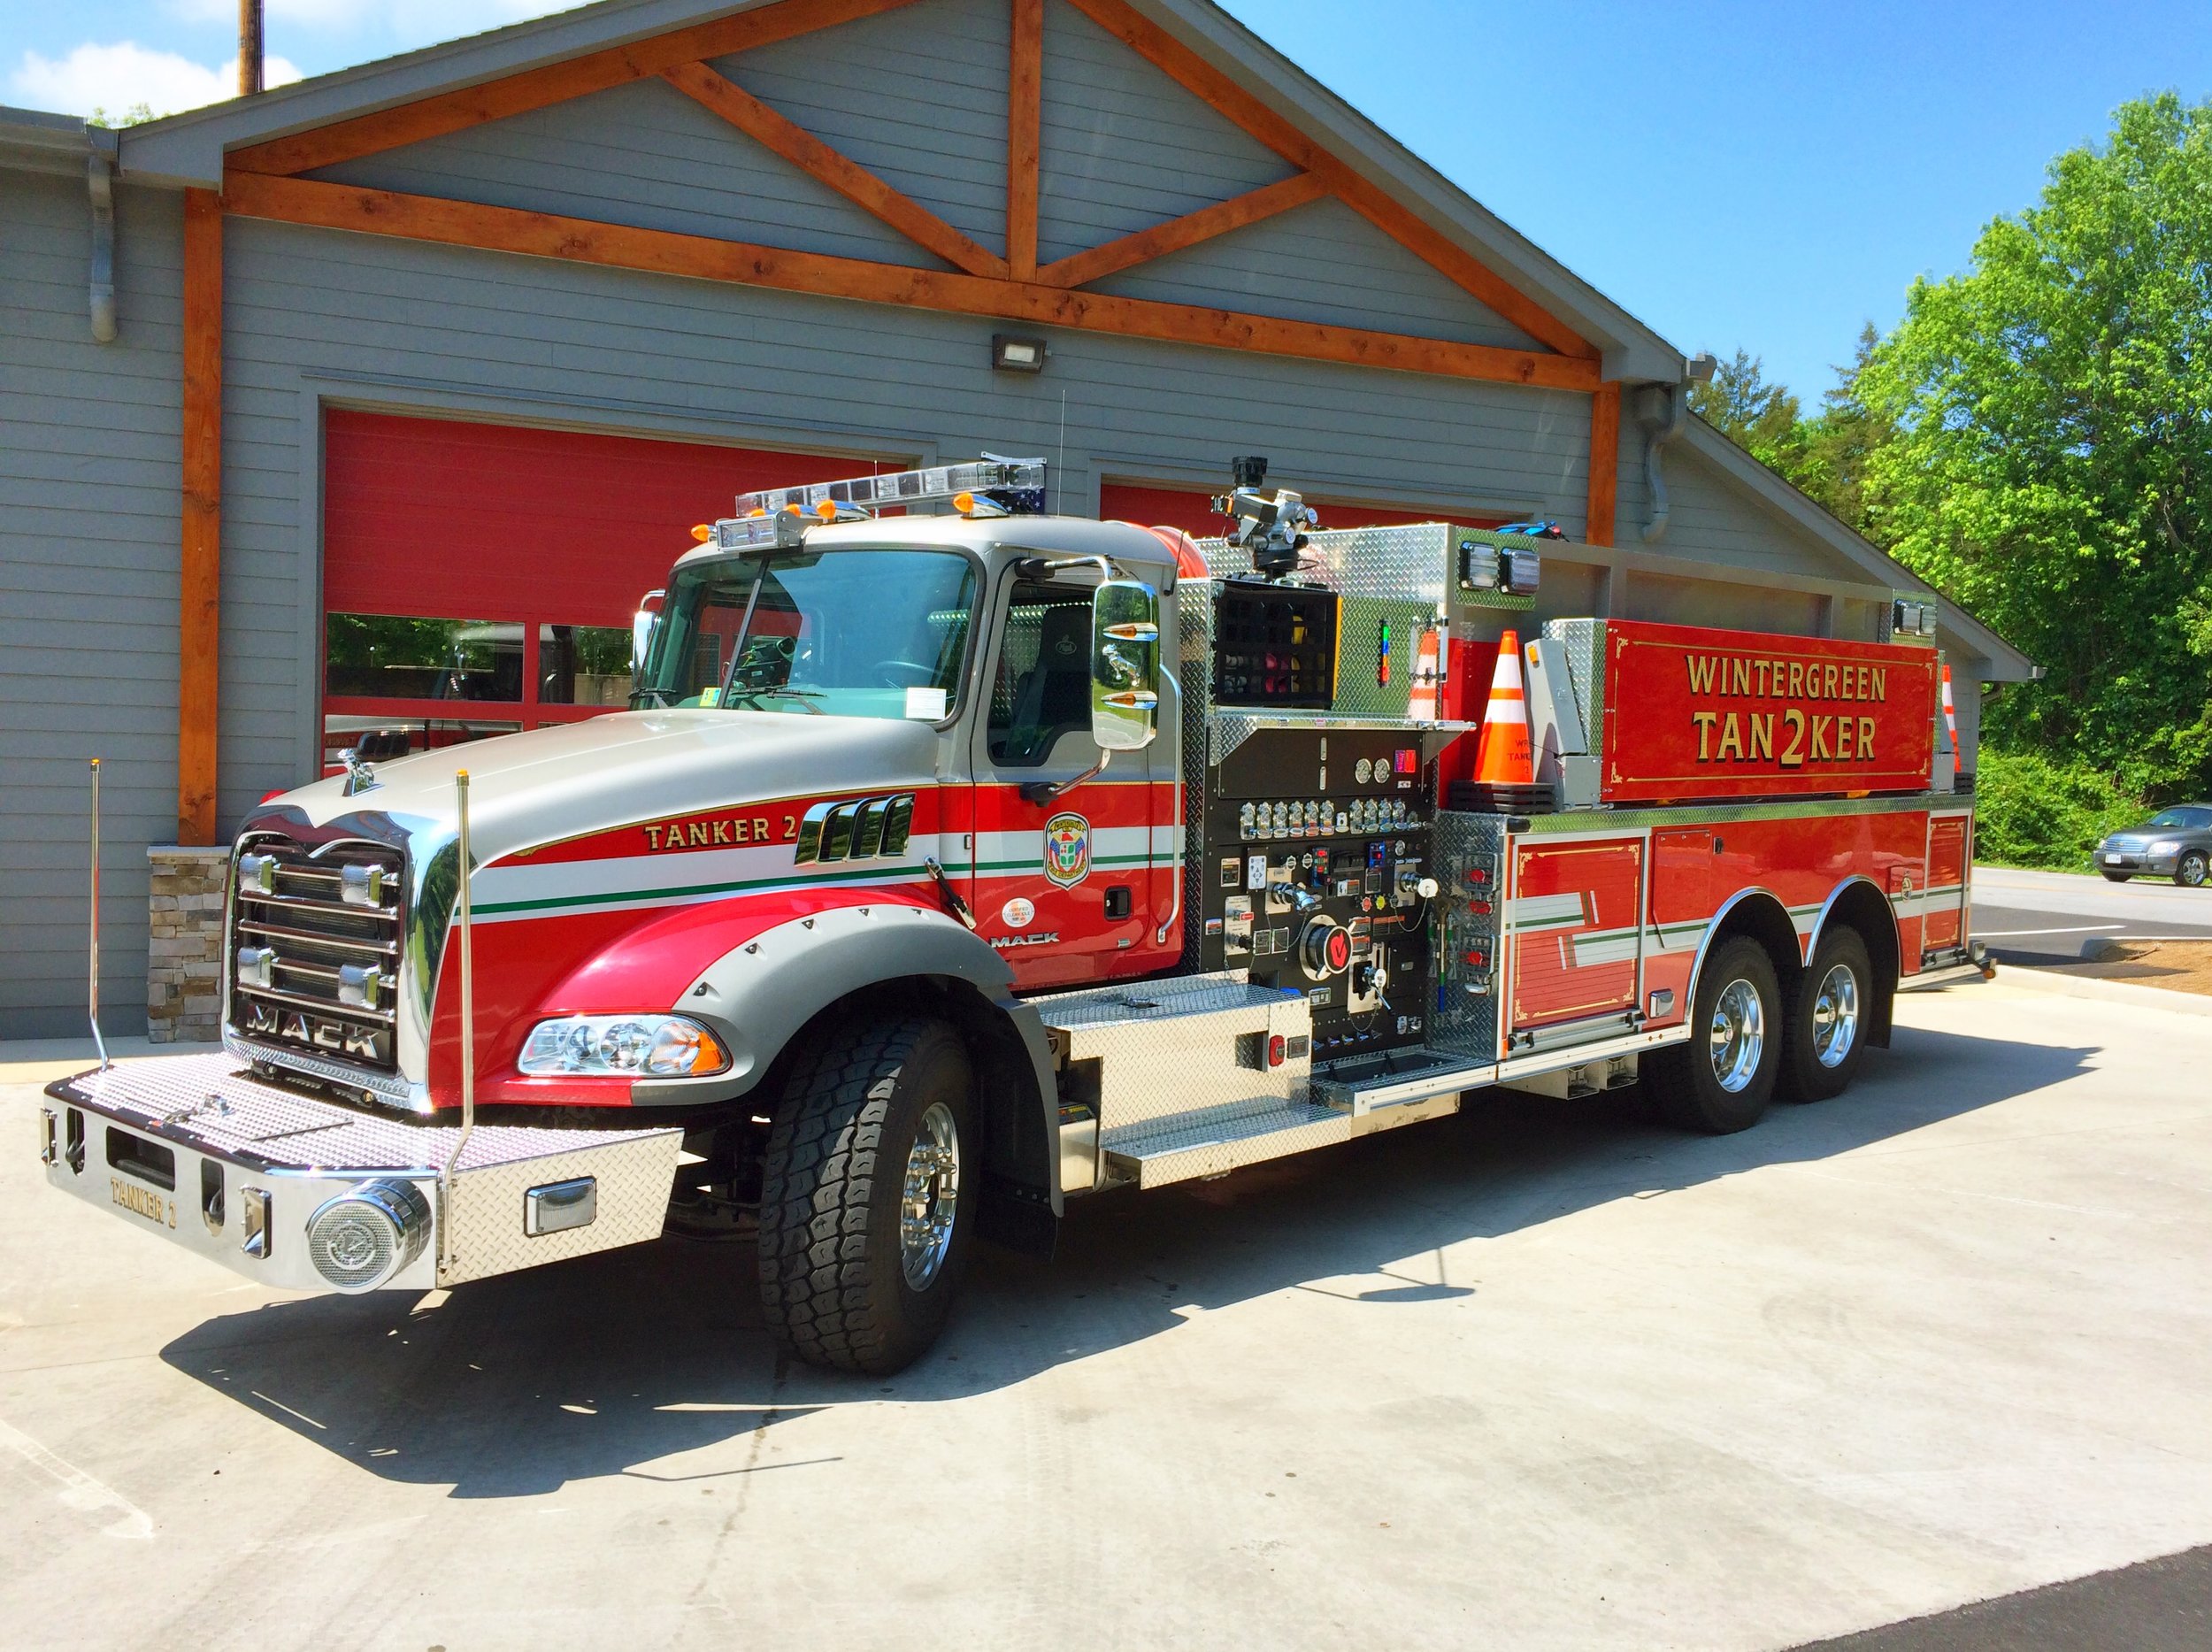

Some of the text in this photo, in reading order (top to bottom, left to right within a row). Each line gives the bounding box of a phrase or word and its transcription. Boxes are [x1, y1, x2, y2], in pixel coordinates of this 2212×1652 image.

[1686, 655, 1886, 701] WINTERGREEN
[644, 815, 796, 851] TANKER 2
[991, 932, 1060, 949] MACK
[246, 1005, 378, 1060] MACK
[111, 1176, 176, 1229] TANKER 2
